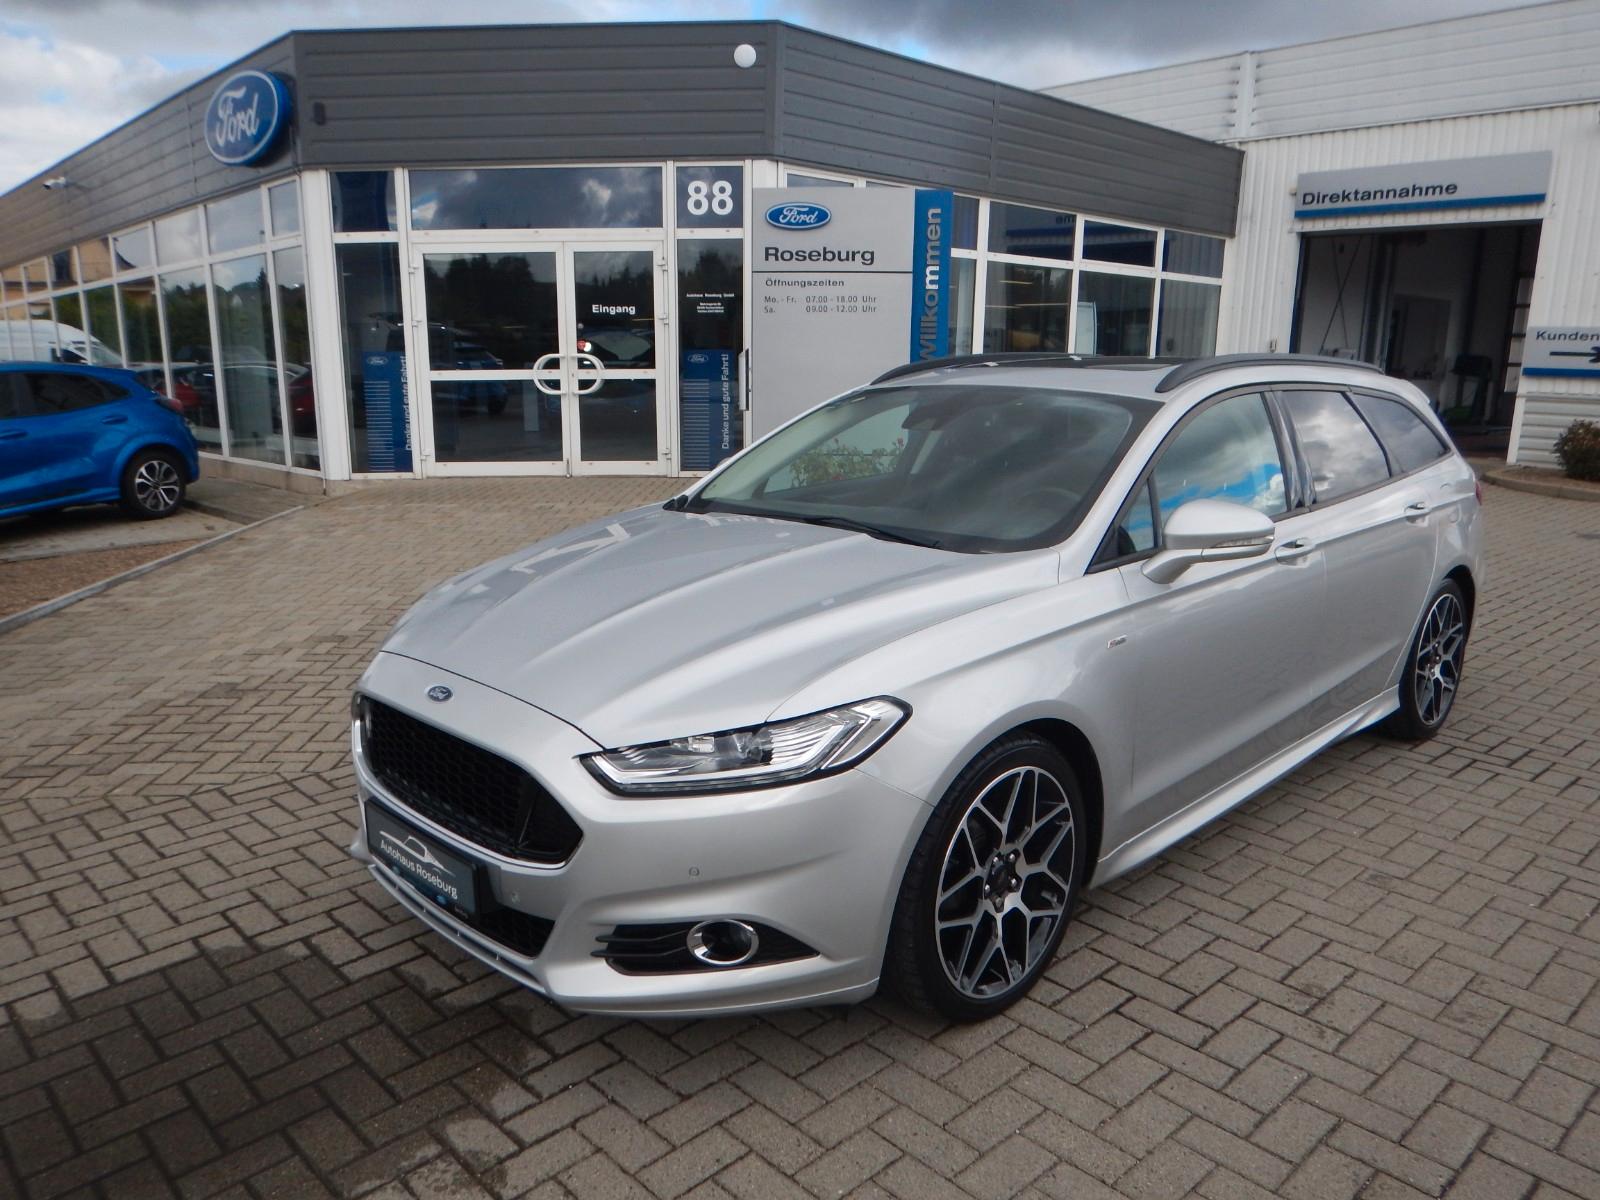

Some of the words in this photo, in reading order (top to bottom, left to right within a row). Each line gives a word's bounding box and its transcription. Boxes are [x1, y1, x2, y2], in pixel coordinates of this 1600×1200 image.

[216, 86, 259, 147] Ford
[687, 180, 733, 215] 88
[1302, 182, 1458, 206] Direktannahme
[779, 206, 818, 224] Ford
[764, 246, 875, 266] Roseburg
[765, 278, 845, 288] Öffnungszeiten
[591, 304, 636, 315] Eingang
[862, 296, 877, 304] Uhr
[862, 305, 877, 313] Uhr
[1536, 331, 1600, 341] Kunden
[722, 382, 731, 402] gute
[381, 840, 415, 871] Autohaus
[416, 864, 458, 900] Roseburg
